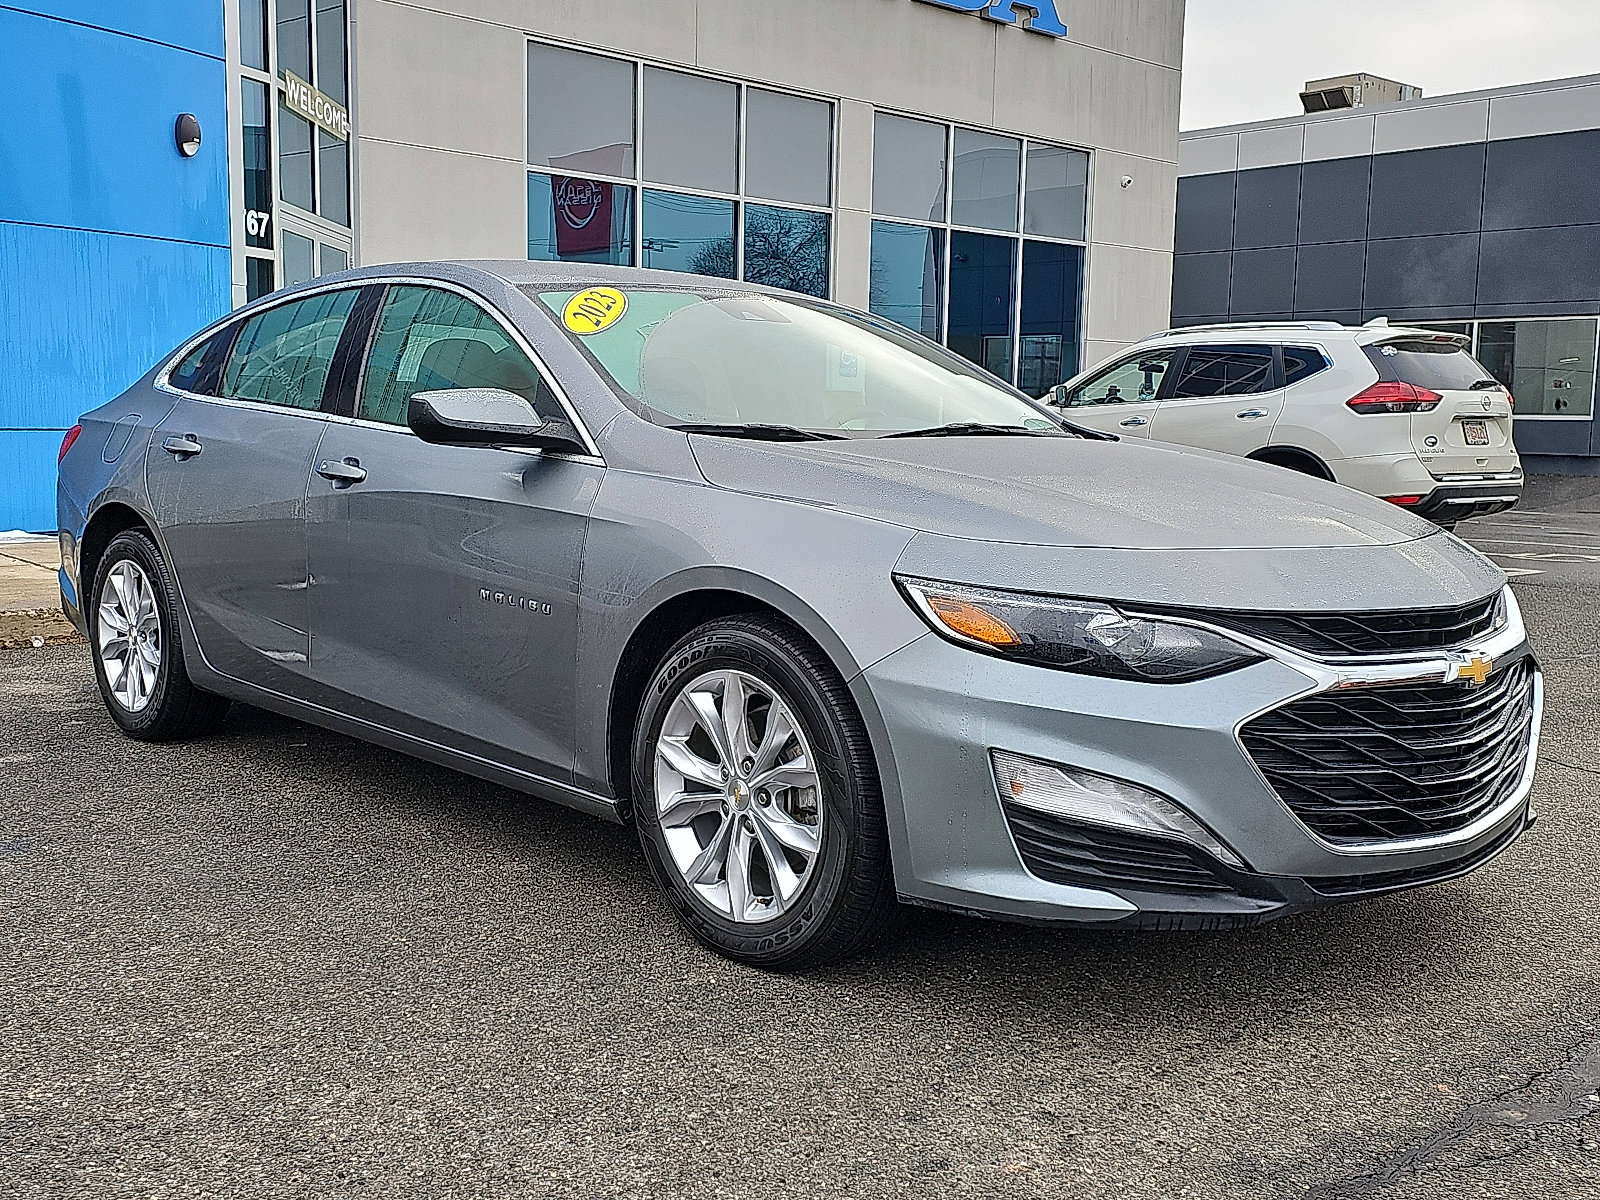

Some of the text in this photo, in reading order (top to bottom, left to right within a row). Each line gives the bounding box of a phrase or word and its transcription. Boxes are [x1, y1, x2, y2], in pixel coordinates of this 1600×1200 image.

[286, 75, 348, 137] WELCOME
[243, 209, 270, 238] 67
[572, 291, 617, 328] 2023
[479, 588, 552, 616] MALIBU
